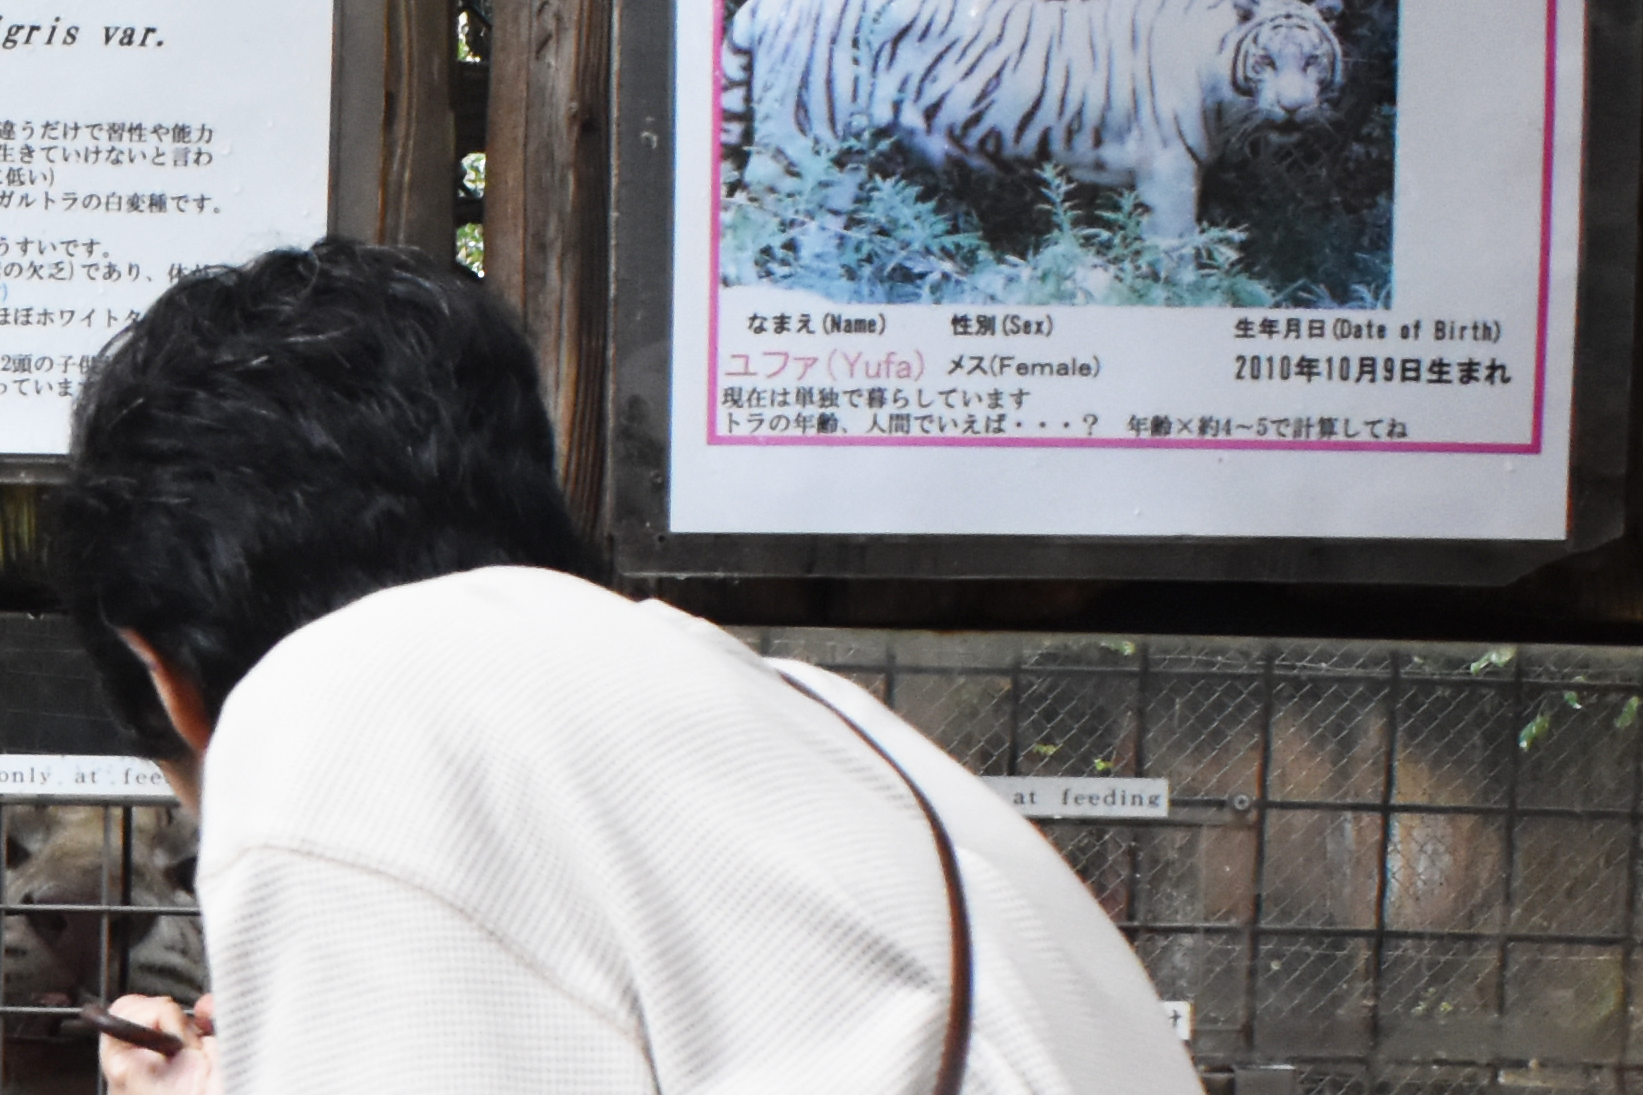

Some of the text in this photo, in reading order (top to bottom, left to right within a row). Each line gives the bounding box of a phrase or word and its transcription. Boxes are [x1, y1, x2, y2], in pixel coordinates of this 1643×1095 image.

[102, 24, 165, 48] var.
[747, 312, 887, 336] なまえ(Name)
[951, 313, 1053, 337] 性別(Sex)
[1399, 322, 1421, 341] of
[1433, 321, 1501, 343] Birth)
[947, 354, 1101, 379] メス(Female)
[1234, 355, 1512, 386] 2010年10月9日生まれ
[722, 386, 1031, 411] 現在は単独で暮らしています
[75, 769, 98, 784] at
[124, 767, 170, 785] fee
[1012, 788, 1161, 808] at feeding
